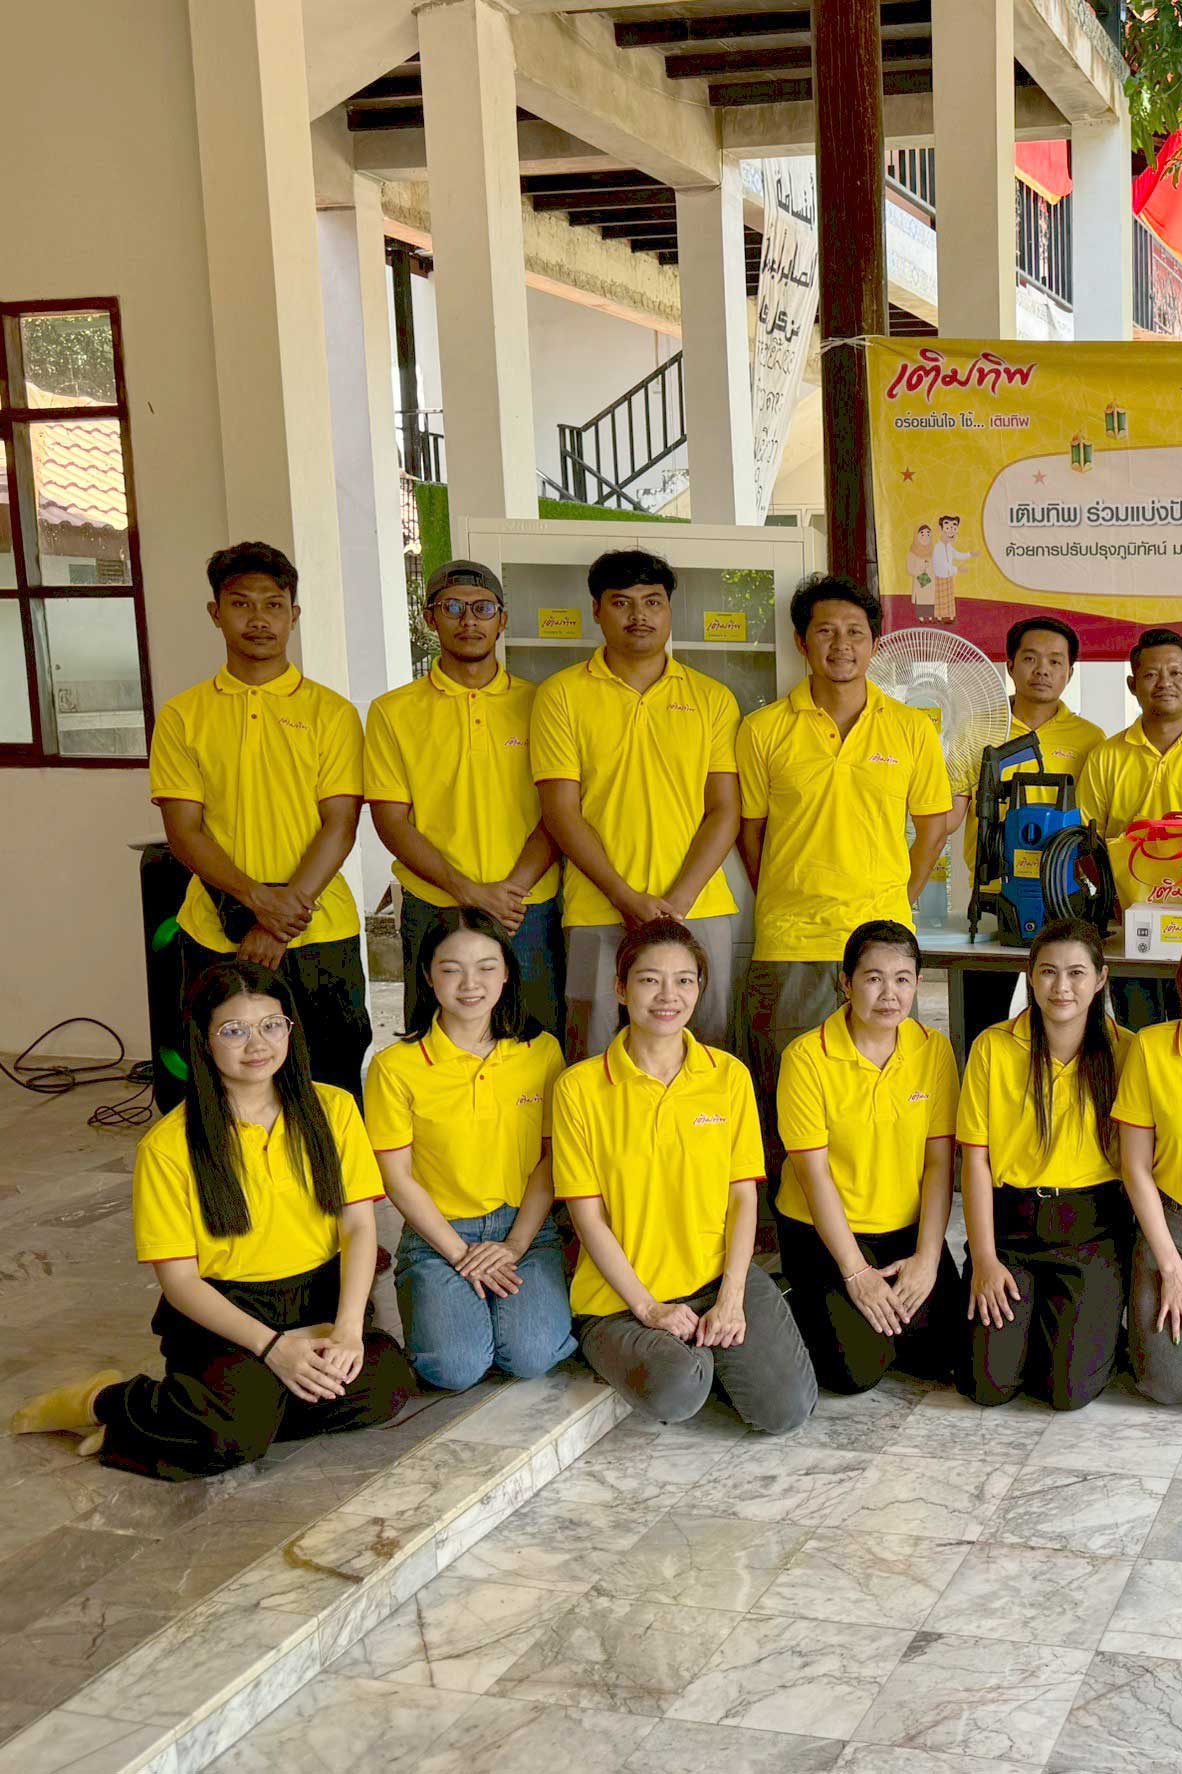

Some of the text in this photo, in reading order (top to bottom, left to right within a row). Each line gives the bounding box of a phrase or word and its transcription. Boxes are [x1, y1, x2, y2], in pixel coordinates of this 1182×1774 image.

[886, 347, 1038, 402] เติมทิพ
[894, 411, 956, 428] อร่อยมั่นใจ
[989, 414, 1030, 428] เติมทิพ
[1009, 503, 1078, 524] เติมทิพ
[1005, 540, 1167, 560] ด้วยการปรับปรุงภูมิทัศน์
